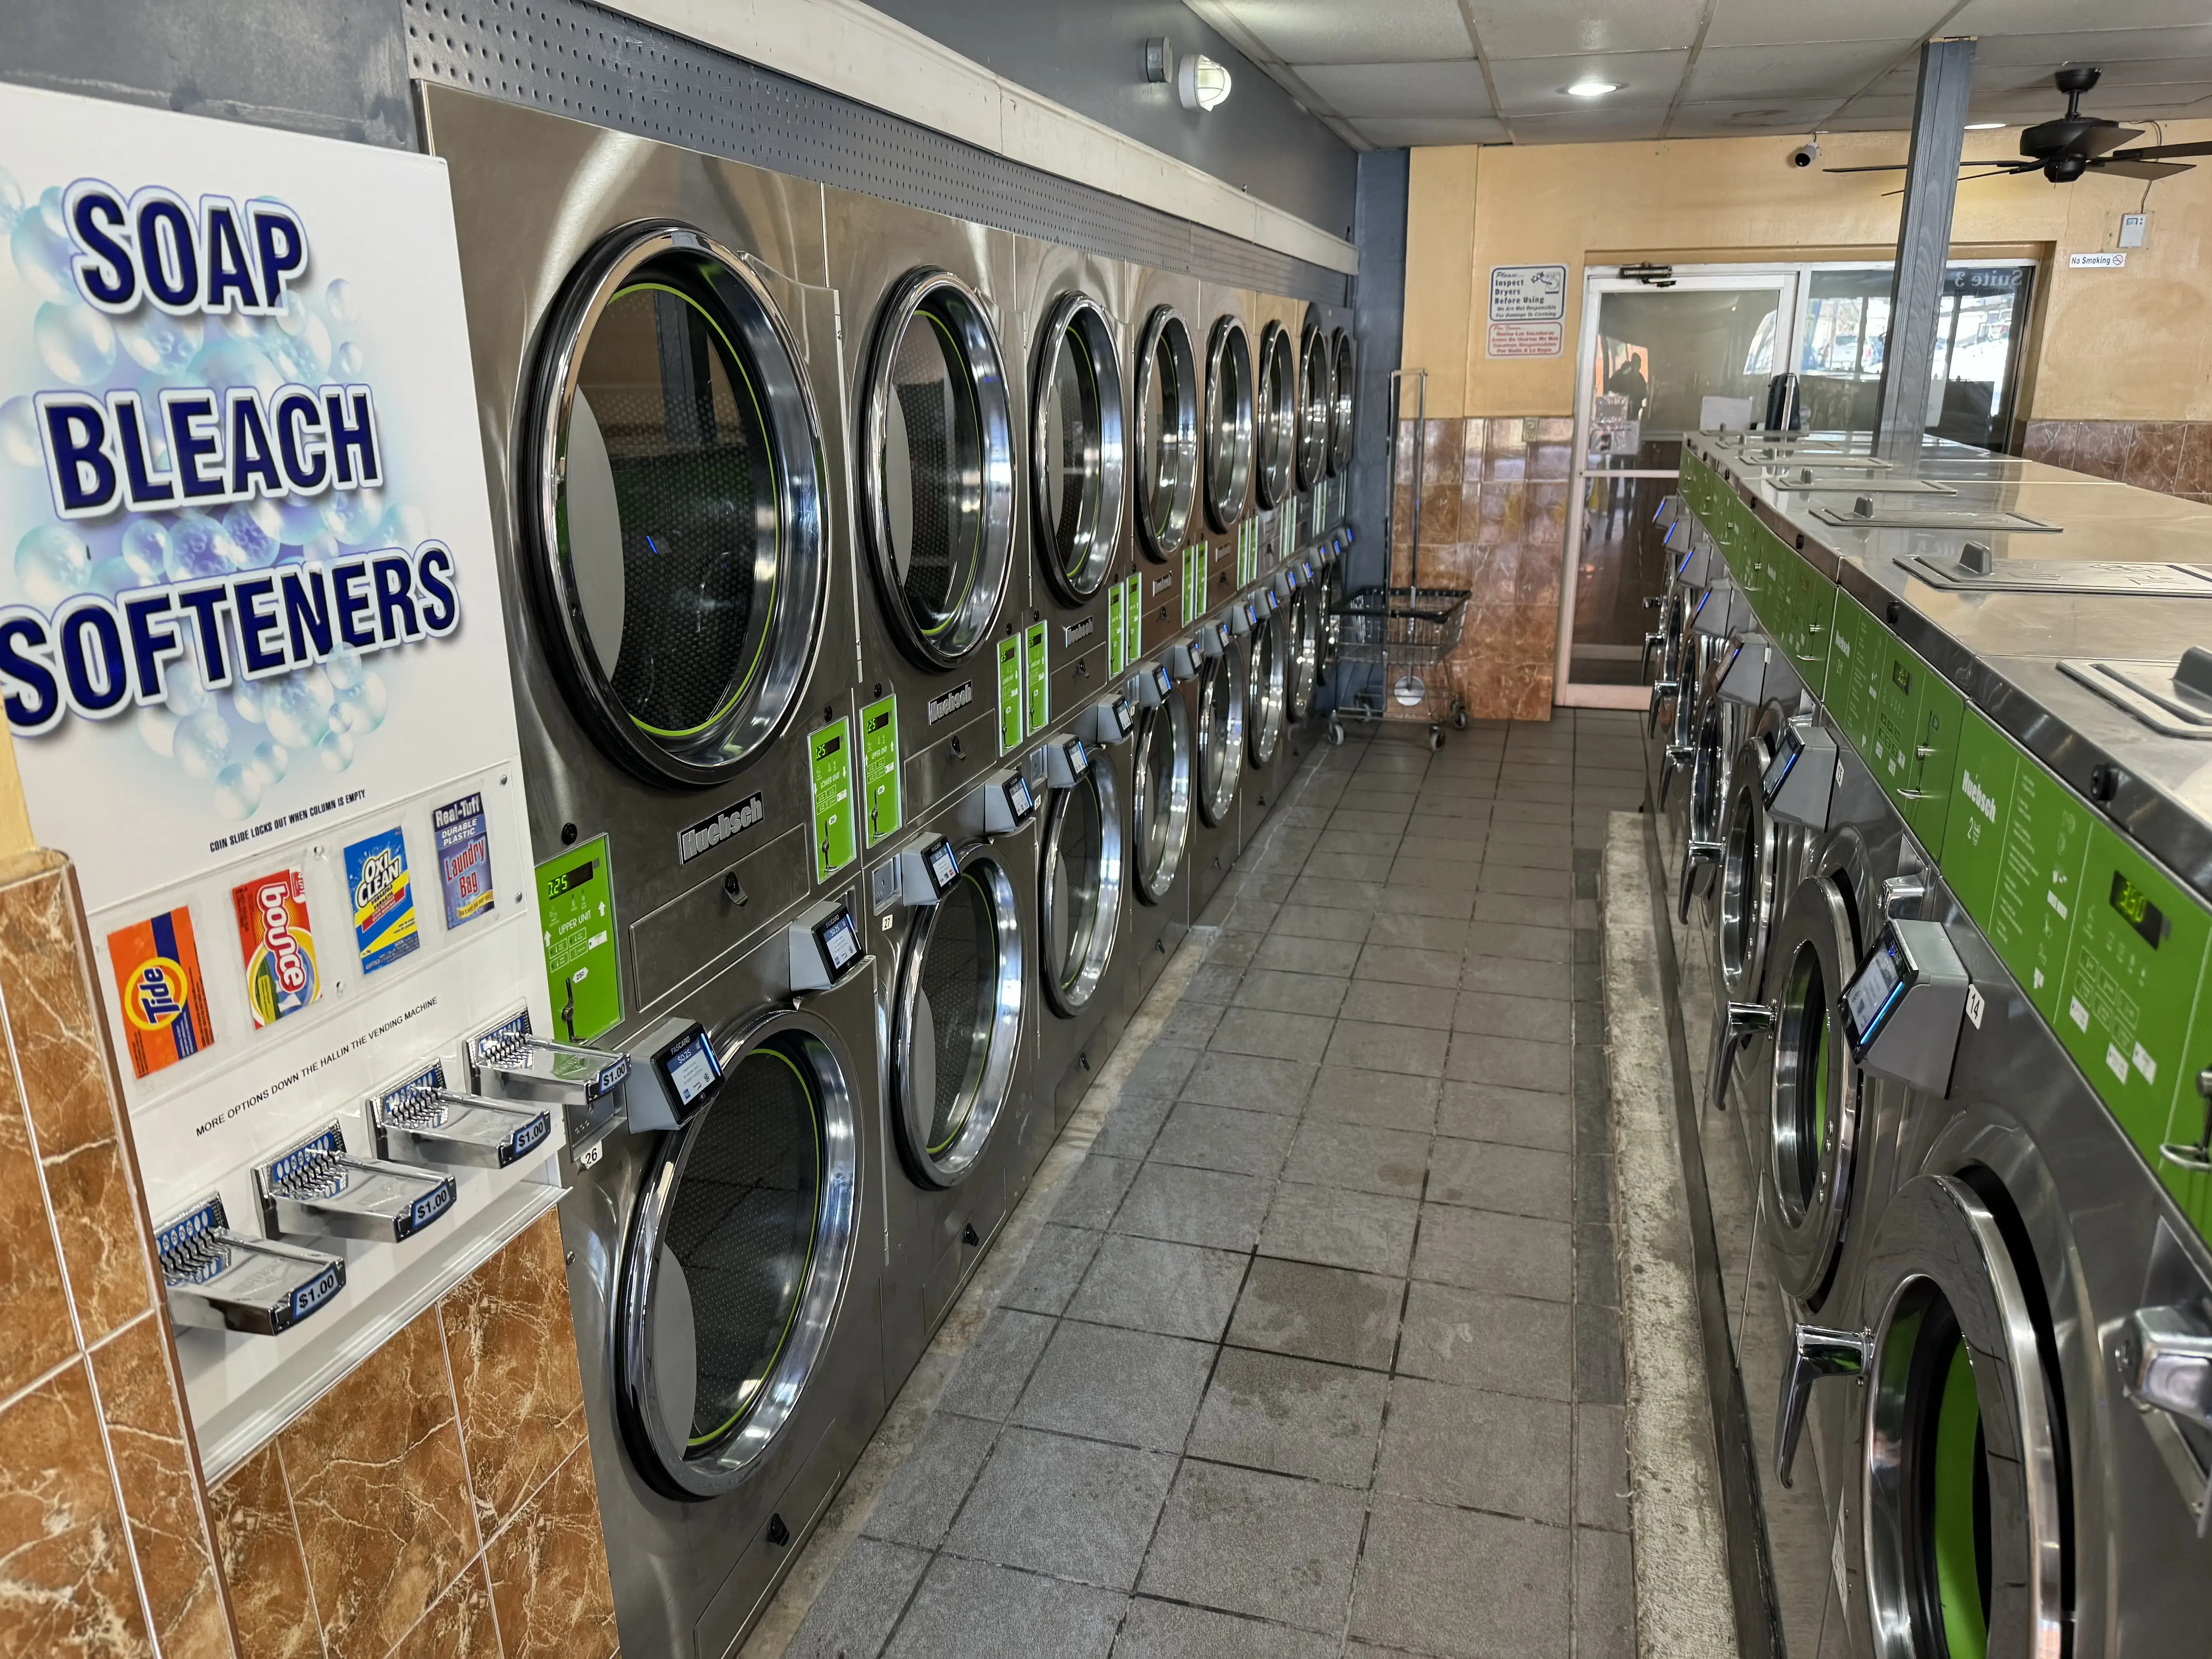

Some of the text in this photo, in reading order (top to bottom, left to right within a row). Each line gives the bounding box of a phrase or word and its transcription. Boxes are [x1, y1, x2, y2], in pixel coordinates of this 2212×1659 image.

[68, 184, 307, 313] SOAP
[2082, 256, 2111, 265] Smoking
[1523, 295, 1544, 304] Using
[40, 389, 381, 515] BLEACH
[0, 544, 460, 733] SOFTENERS
[1836, 630, 1850, 658] Huebsch
[931, 685, 972, 723] Huebsch
[821, 778, 832, 789] LOWER
[1962, 769, 1996, 823] Huebsch
[210, 789, 365, 852] COIN SLIDE LOCKS OUT WHEN COLUMN IS EMPTY
[435, 795, 480, 828] Real-Tuff
[442, 818, 477, 839] DURABLE
[443, 828, 475, 847] PLASTIC
[682, 797, 763, 860] Huebsch
[365, 850, 388, 884] OXI
[445, 838, 485, 882] Laundry
[357, 858, 400, 908] CLEAN
[459, 871, 478, 899] Bag
[558, 918, 577, 935] UPPER
[578, 910, 591, 924] UNIT
[826, 914, 840, 929] FASCARD
[830, 925, 840, 936] $0.25
[884, 917, 890, 928] 27
[259, 883, 306, 989] bounce
[576, 971, 584, 980] 25¢
[138, 967, 182, 1025] Tide
[1970, 992, 1980, 1020] 14
[670, 1036, 690, 1055] FASCARD
[677, 1049, 692, 1064] $0.25
[196, 1115, 226, 1137] MORE
[227, 1089, 269, 1118] OPTIONS
[271, 1073, 299, 1095] DOWN
[301, 1062, 319, 1078] THE
[350, 1035, 367, 1049] THE
[368, 1015, 403, 1040] VENDING
[404, 996, 438, 1020] MACHINE
[603, 1062, 625, 1087] $1.00
[518, 1121, 544, 1147] $1.00
[585, 1147, 598, 1164] 26
[417, 1190, 447, 1219] $1.00
[298, 1273, 335, 1309] $1.00
